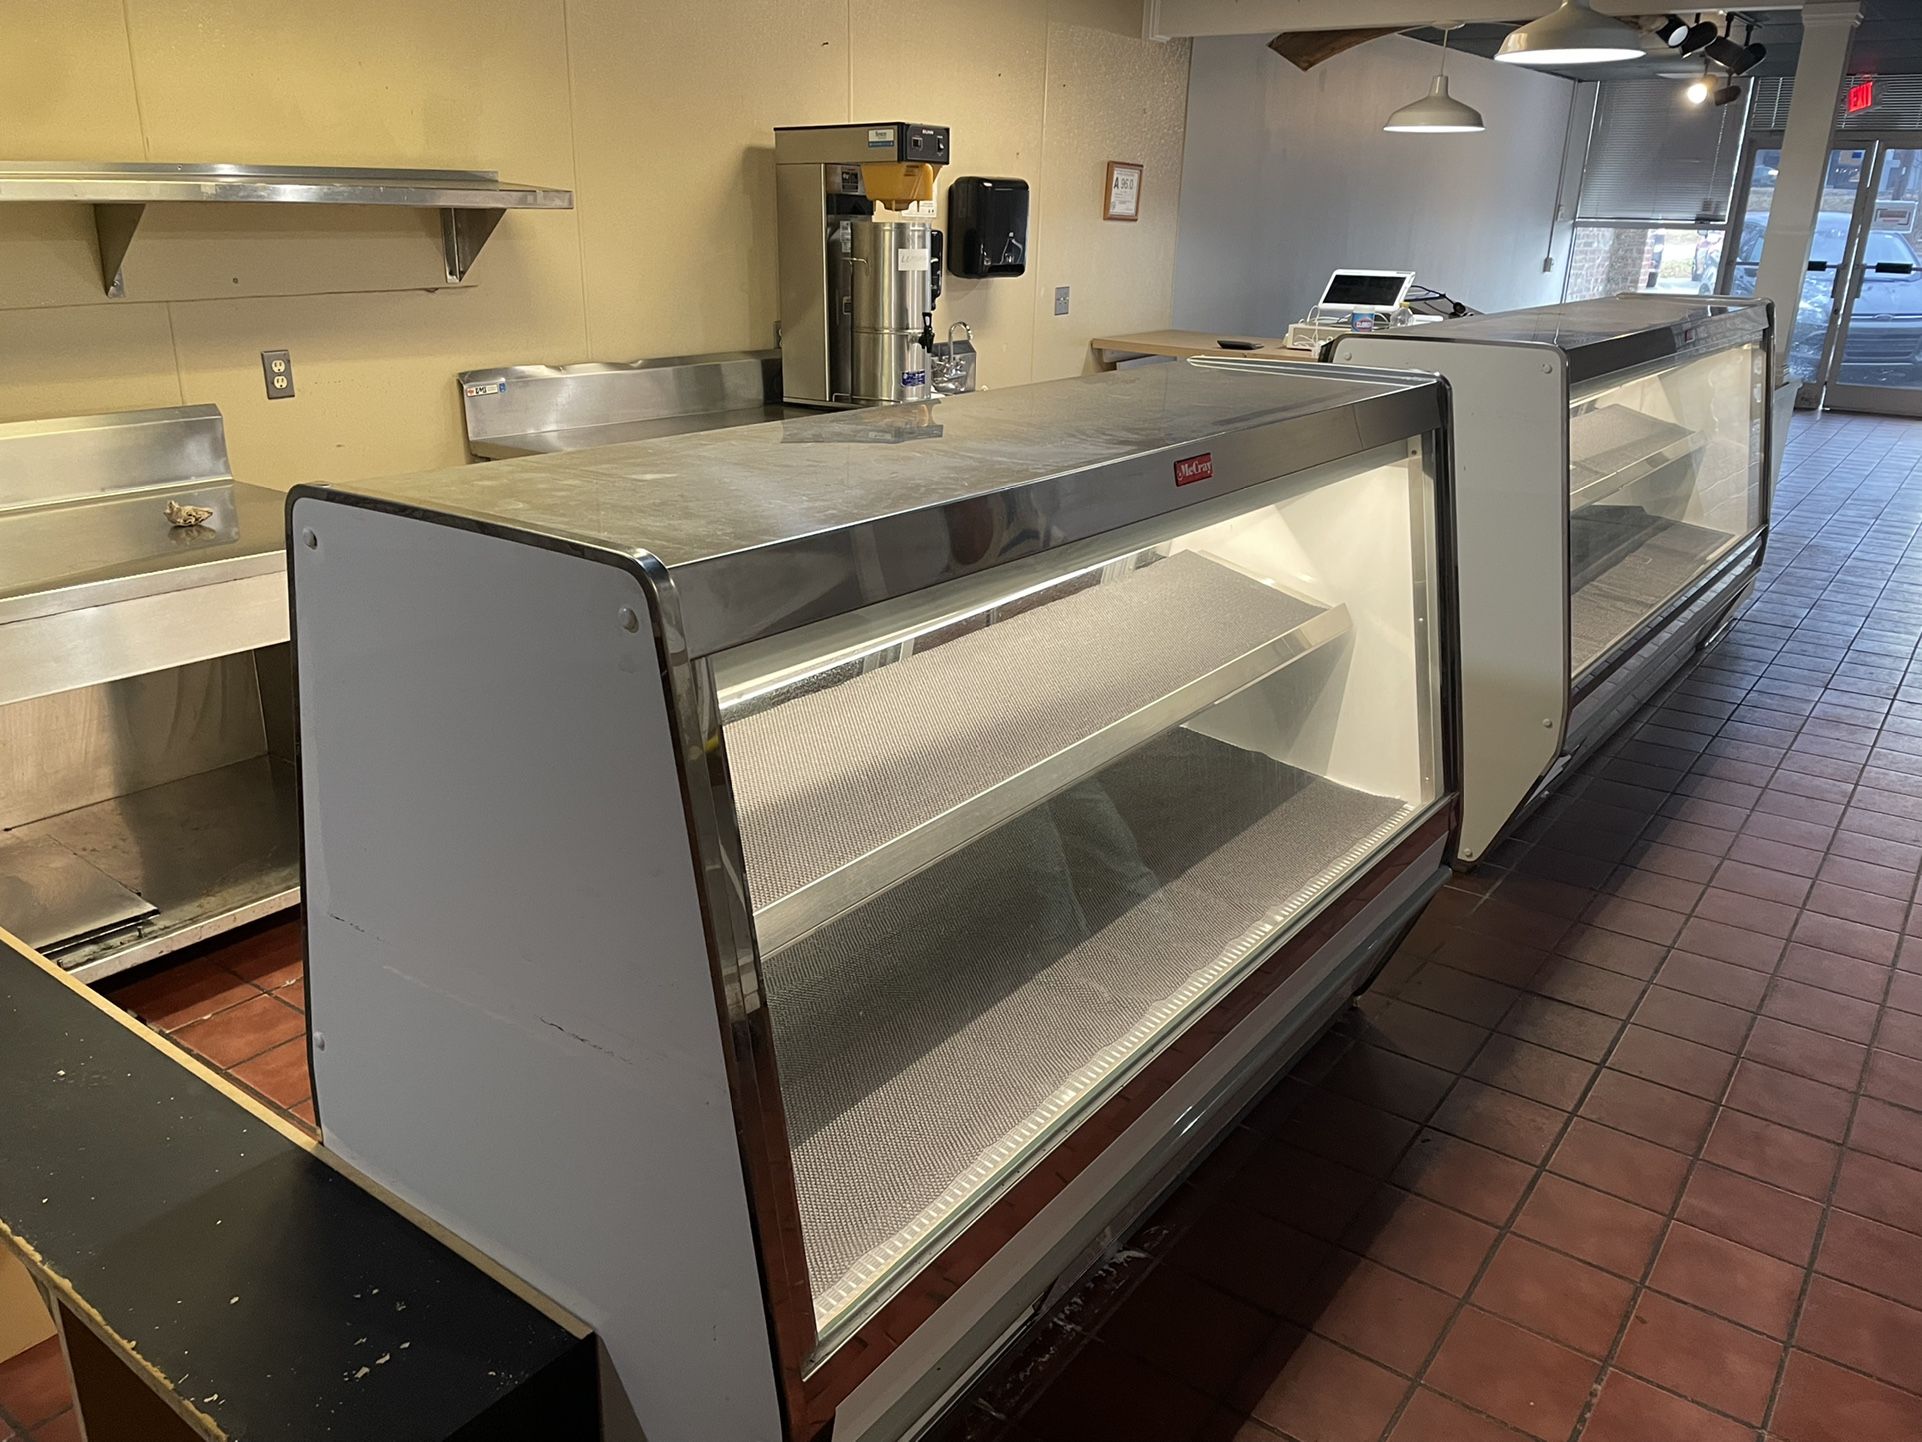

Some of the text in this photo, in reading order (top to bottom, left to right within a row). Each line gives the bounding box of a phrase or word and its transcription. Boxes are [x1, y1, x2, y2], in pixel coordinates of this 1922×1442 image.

[1849, 82, 1873, 111] EXIT
[1113, 177, 1119, 190] A
[1177, 461, 1212, 481] McCray
